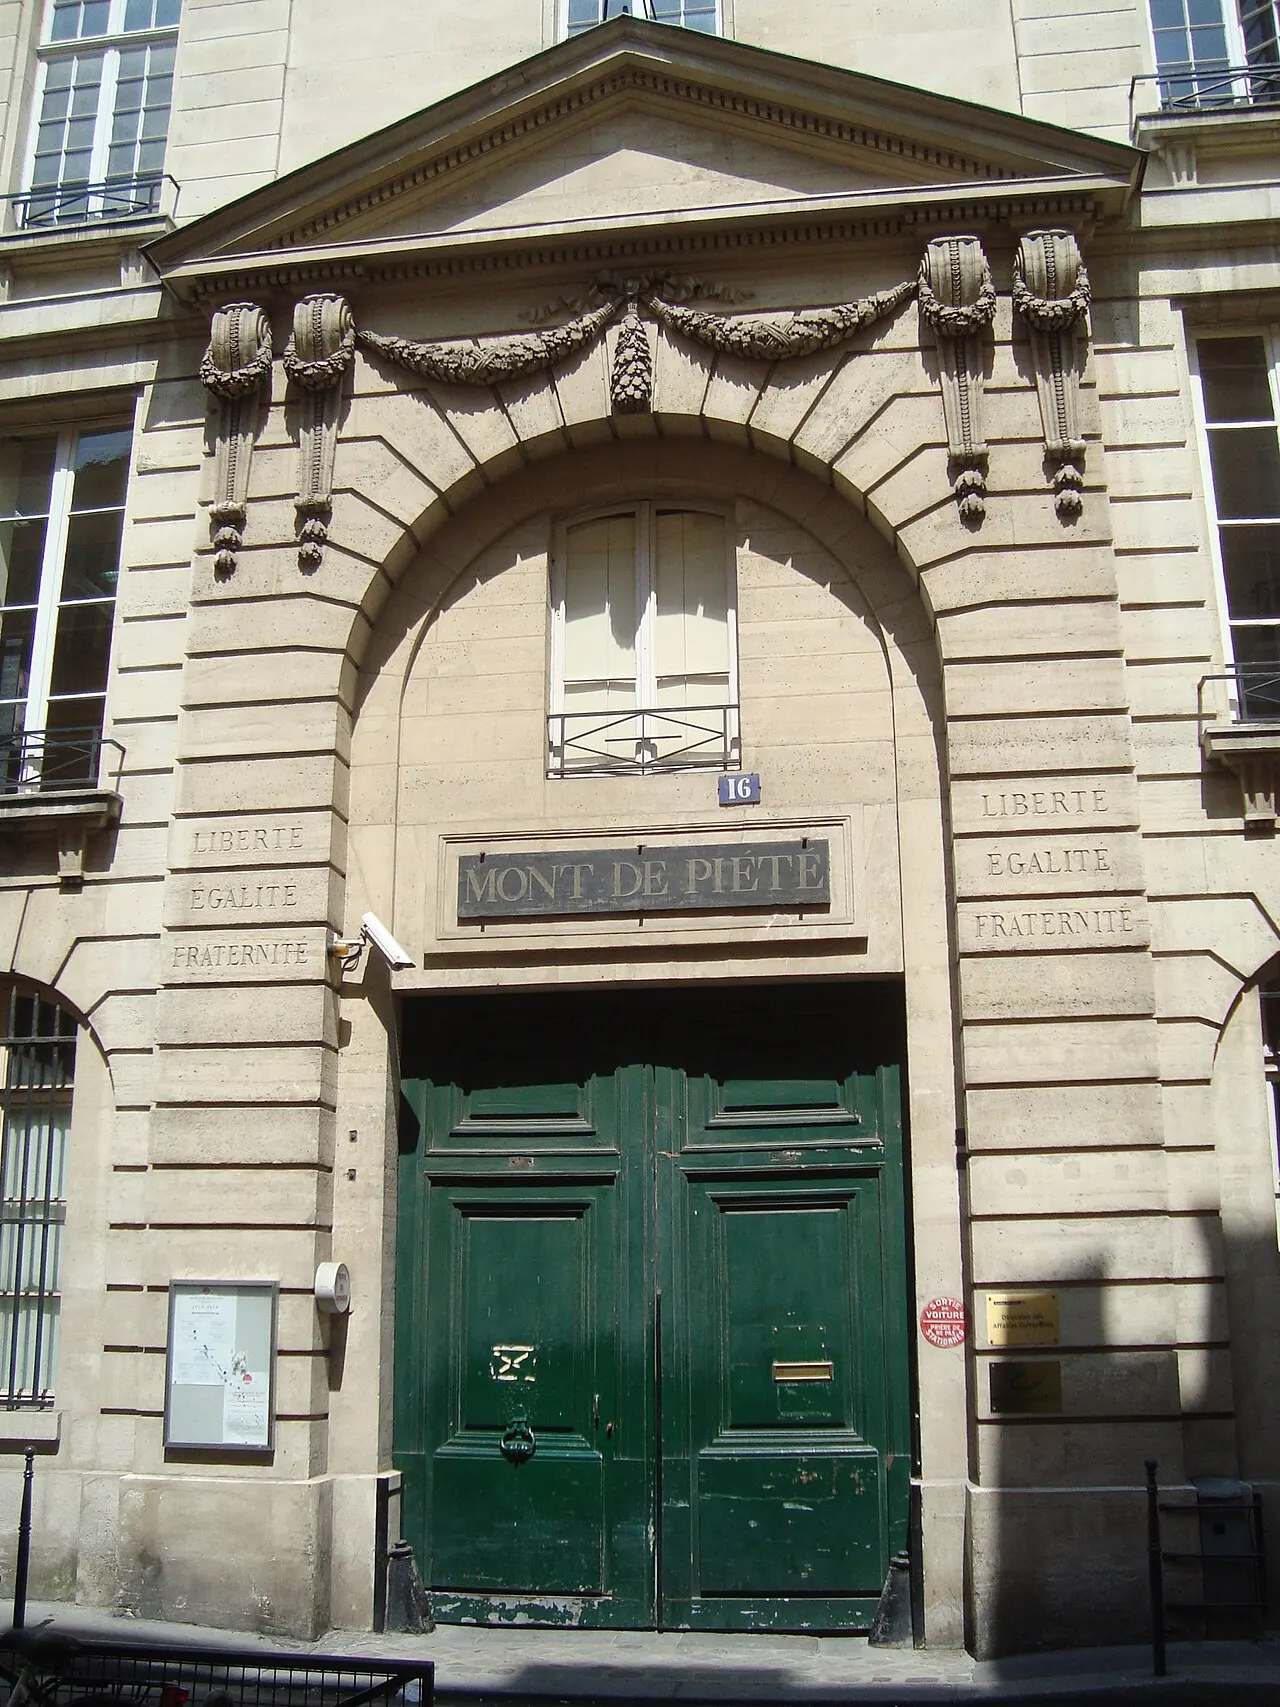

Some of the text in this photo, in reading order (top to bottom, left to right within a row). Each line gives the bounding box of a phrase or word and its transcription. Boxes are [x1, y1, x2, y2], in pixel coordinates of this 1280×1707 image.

[727, 777, 752, 800] 16
[981, 783, 1110, 818] LIBERTÉ
[193, 820, 304, 853] LIBERTÉ
[986, 841, 1111, 876] ÉGALITÉ
[464, 847, 825, 904] MONT DE PIÉTÉ
[190, 877, 298, 910] ÉGALITÉ
[974, 903, 1134, 939] FRATERNITÉ
[172, 936, 309, 968] FRATERNITÉ
[926, 1311, 965, 1319] VOITURE
[929, 1298, 962, 1311] SORTIE
[926, 1329, 965, 1346] STATIONNER
